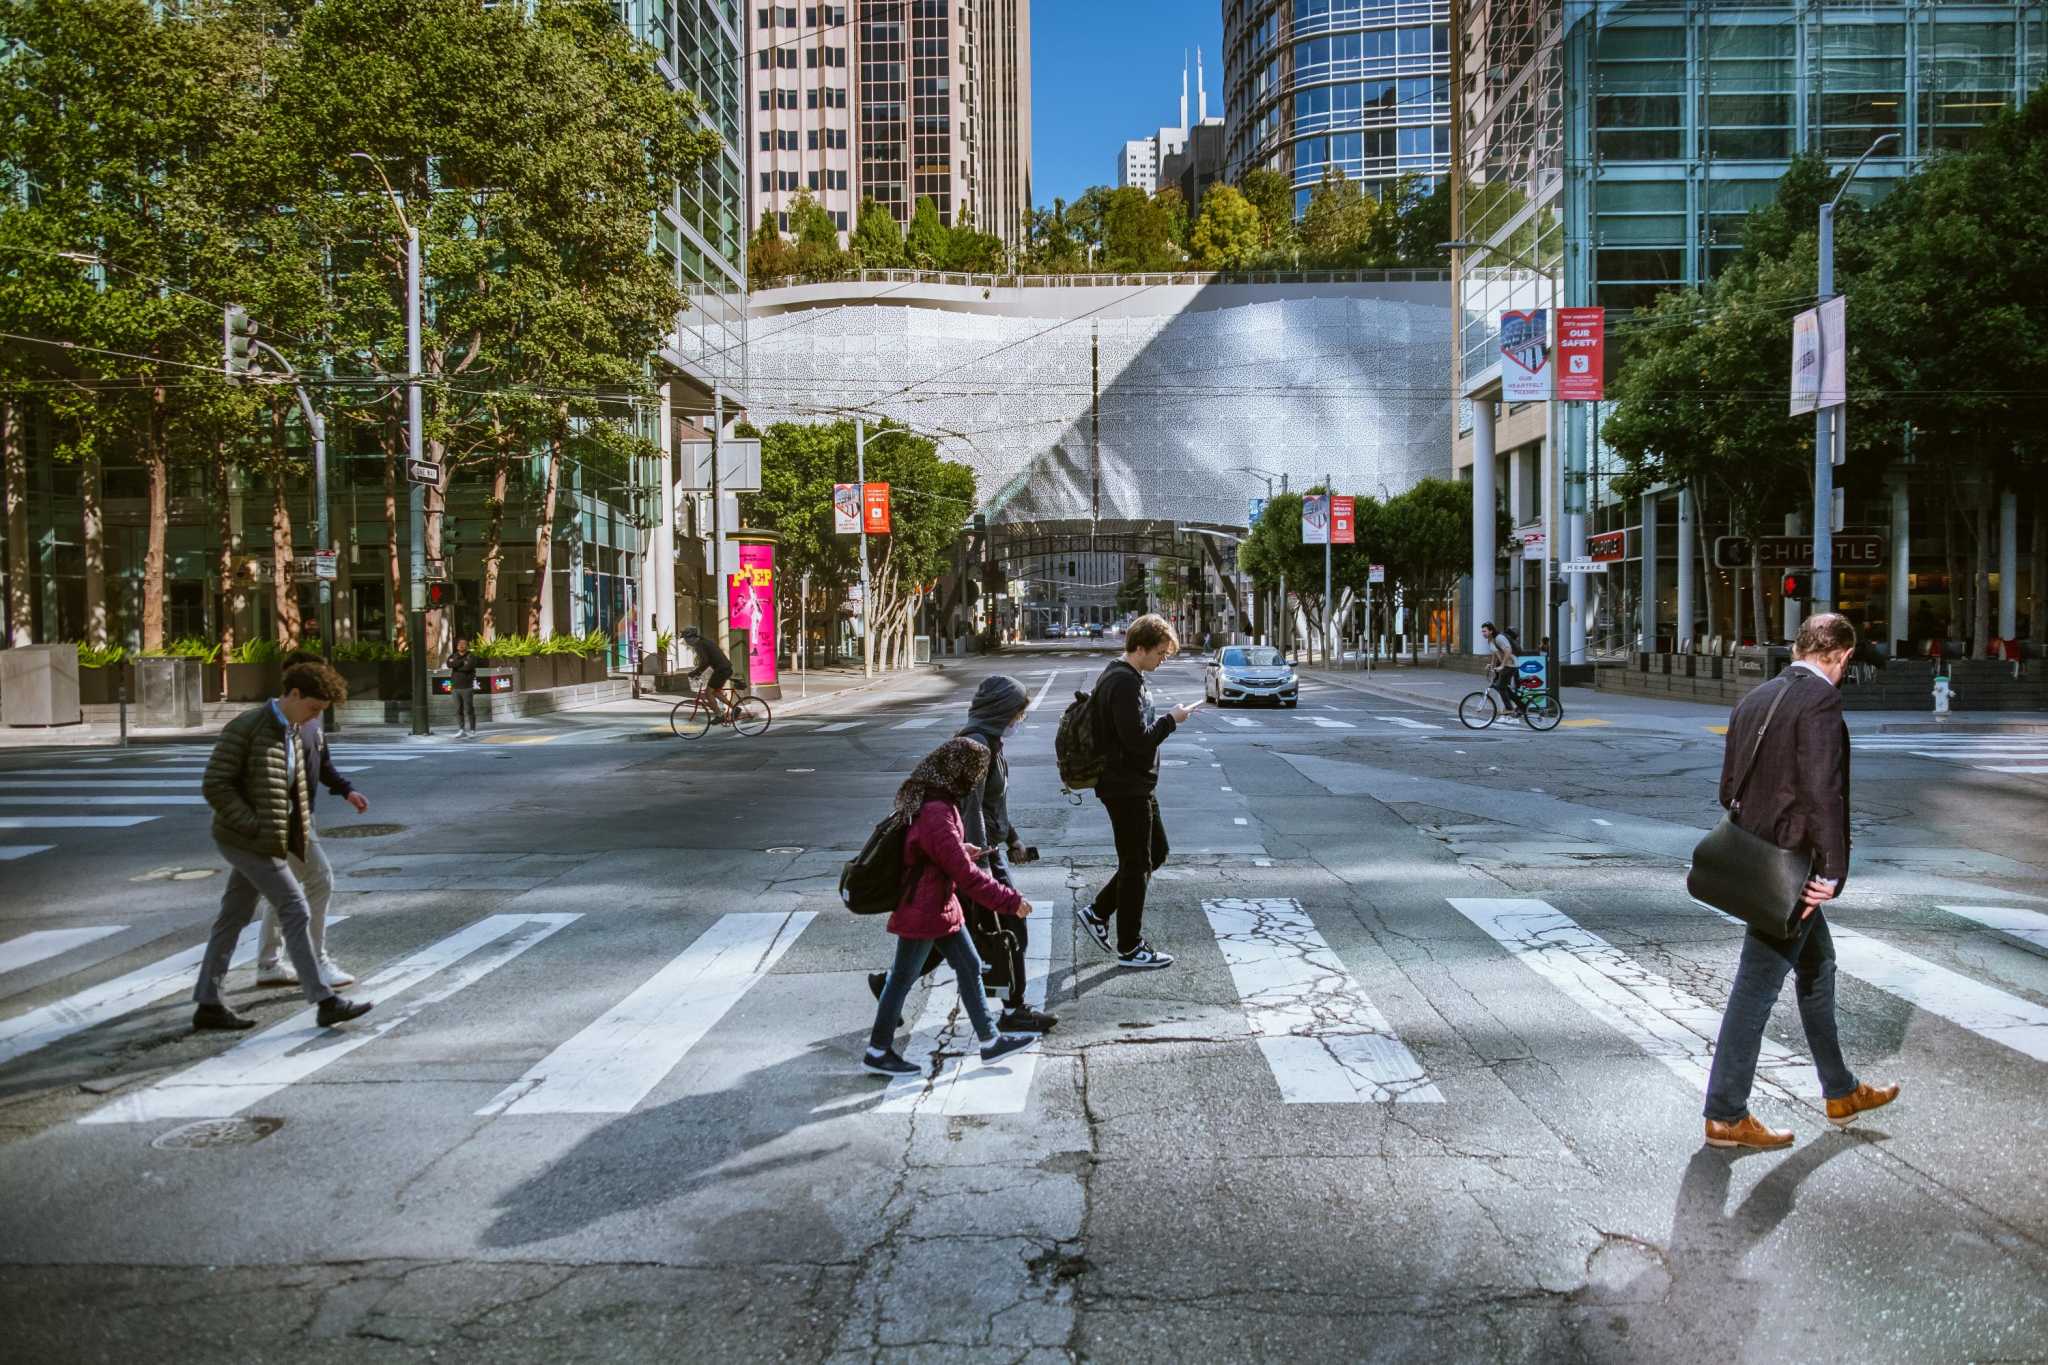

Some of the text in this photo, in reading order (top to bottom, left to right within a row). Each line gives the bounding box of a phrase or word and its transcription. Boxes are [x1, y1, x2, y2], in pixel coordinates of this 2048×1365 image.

[1569, 329, 1590, 337] OUR
[1561, 339, 1597, 347] SAFETY
[416, 468, 426, 476] ONE
[1760, 543, 1877, 560] CHIPTLE
